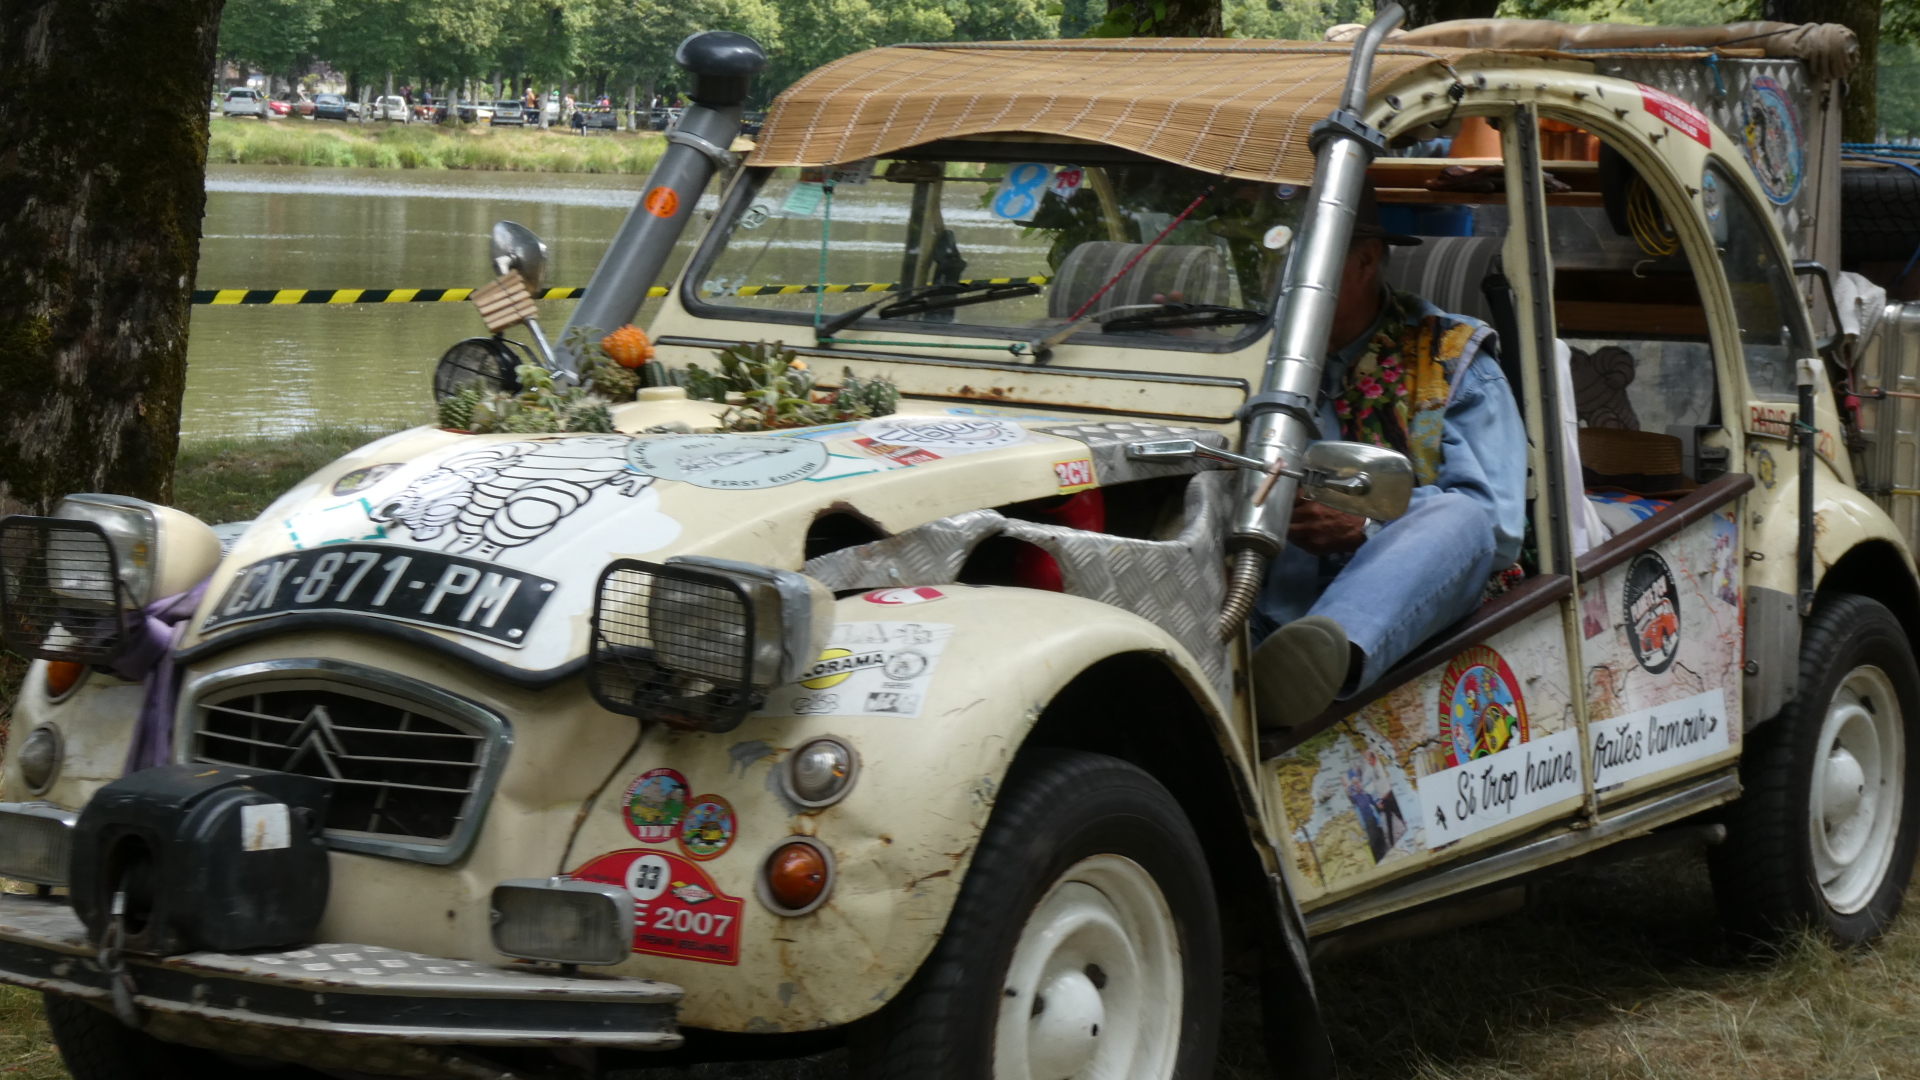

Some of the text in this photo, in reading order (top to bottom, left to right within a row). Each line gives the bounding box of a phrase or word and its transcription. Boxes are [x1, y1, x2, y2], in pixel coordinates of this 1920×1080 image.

[994, 163, 1048, 218] 8
[711, 478, 759, 488] FIRST
[1055, 460, 1090, 486] 2CV
[223, 551, 523, 629] CX-871-PM
[1456, 770, 1477, 821] Si
[1480, 764, 1518, 814] trop
[1593, 723, 1643, 783] faites
[635, 864, 662, 890] 33
[653, 906, 734, 938] 2007
